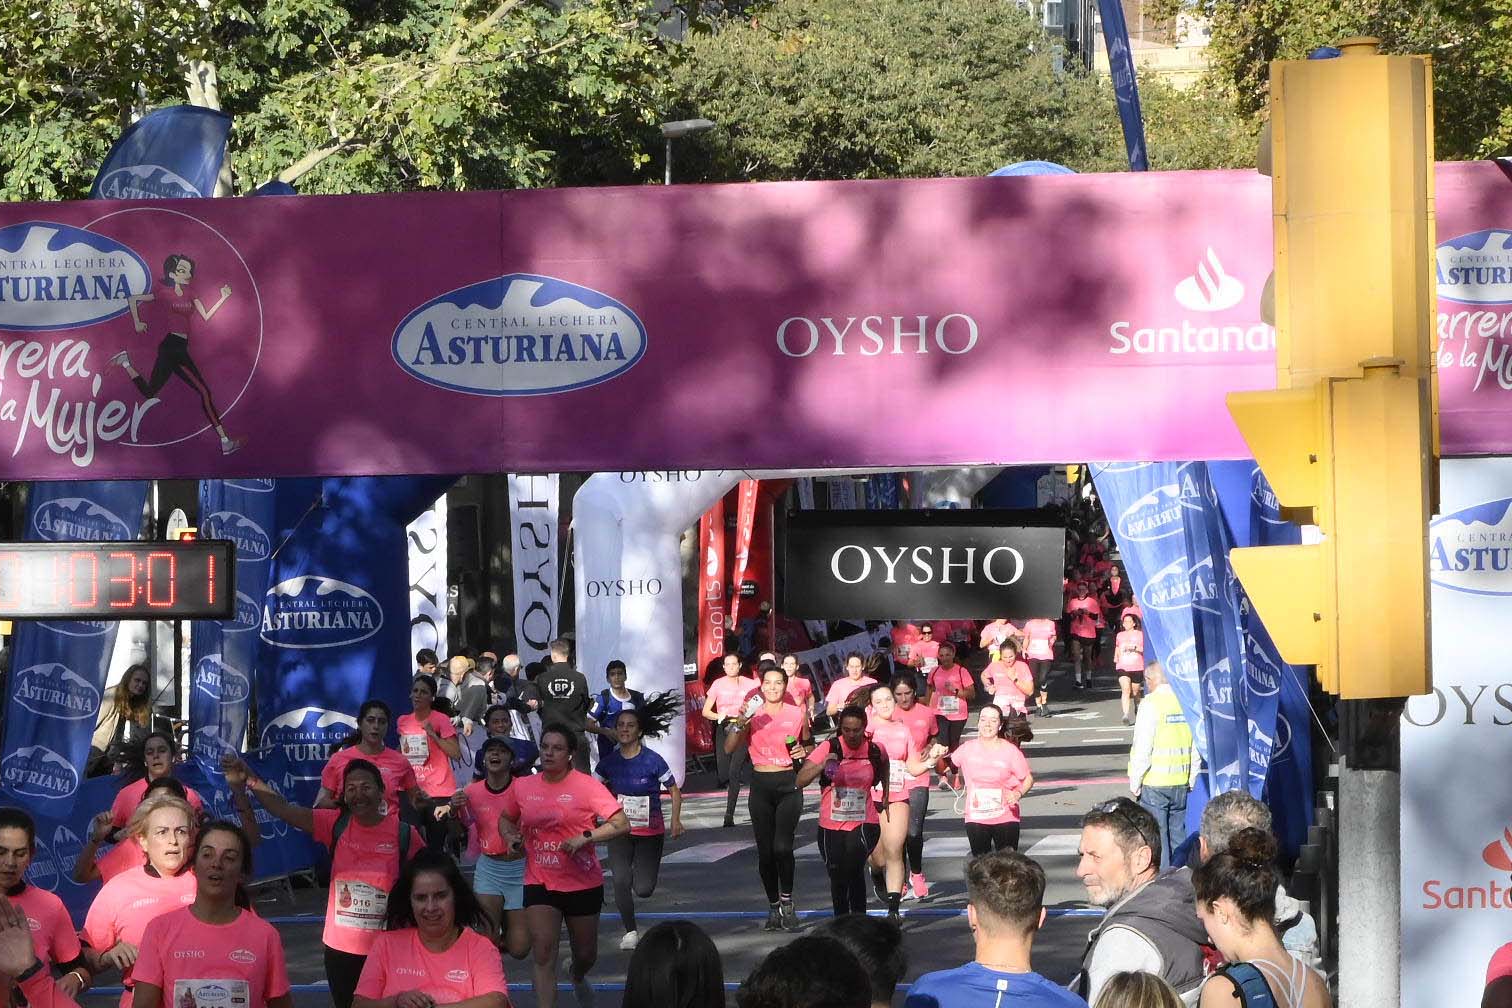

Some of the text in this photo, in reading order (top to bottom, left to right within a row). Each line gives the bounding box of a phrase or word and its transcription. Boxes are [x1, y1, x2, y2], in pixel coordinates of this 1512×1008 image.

[53, 257, 127, 270] LECHERA
[1449, 254, 1500, 265] CENTRAL
[450, 314, 618, 331] CENTRAL LECHERA
[776, 312, 979, 358] OYSHO
[411, 321, 628, 366] ASTURIANA
[1110, 320, 1277, 354] Santand
[1460, 341, 1477, 368] la
[12, 374, 161, 467] Mujer
[830, 544, 1025, 586] OYSHO
[586, 578, 662, 598] OYSHO
[261, 604, 374, 632] ASTURIANA
[16, 677, 93, 713] ASTURIANA
[553, 682, 569, 692] BP
[353, 898, 371, 907] 016
